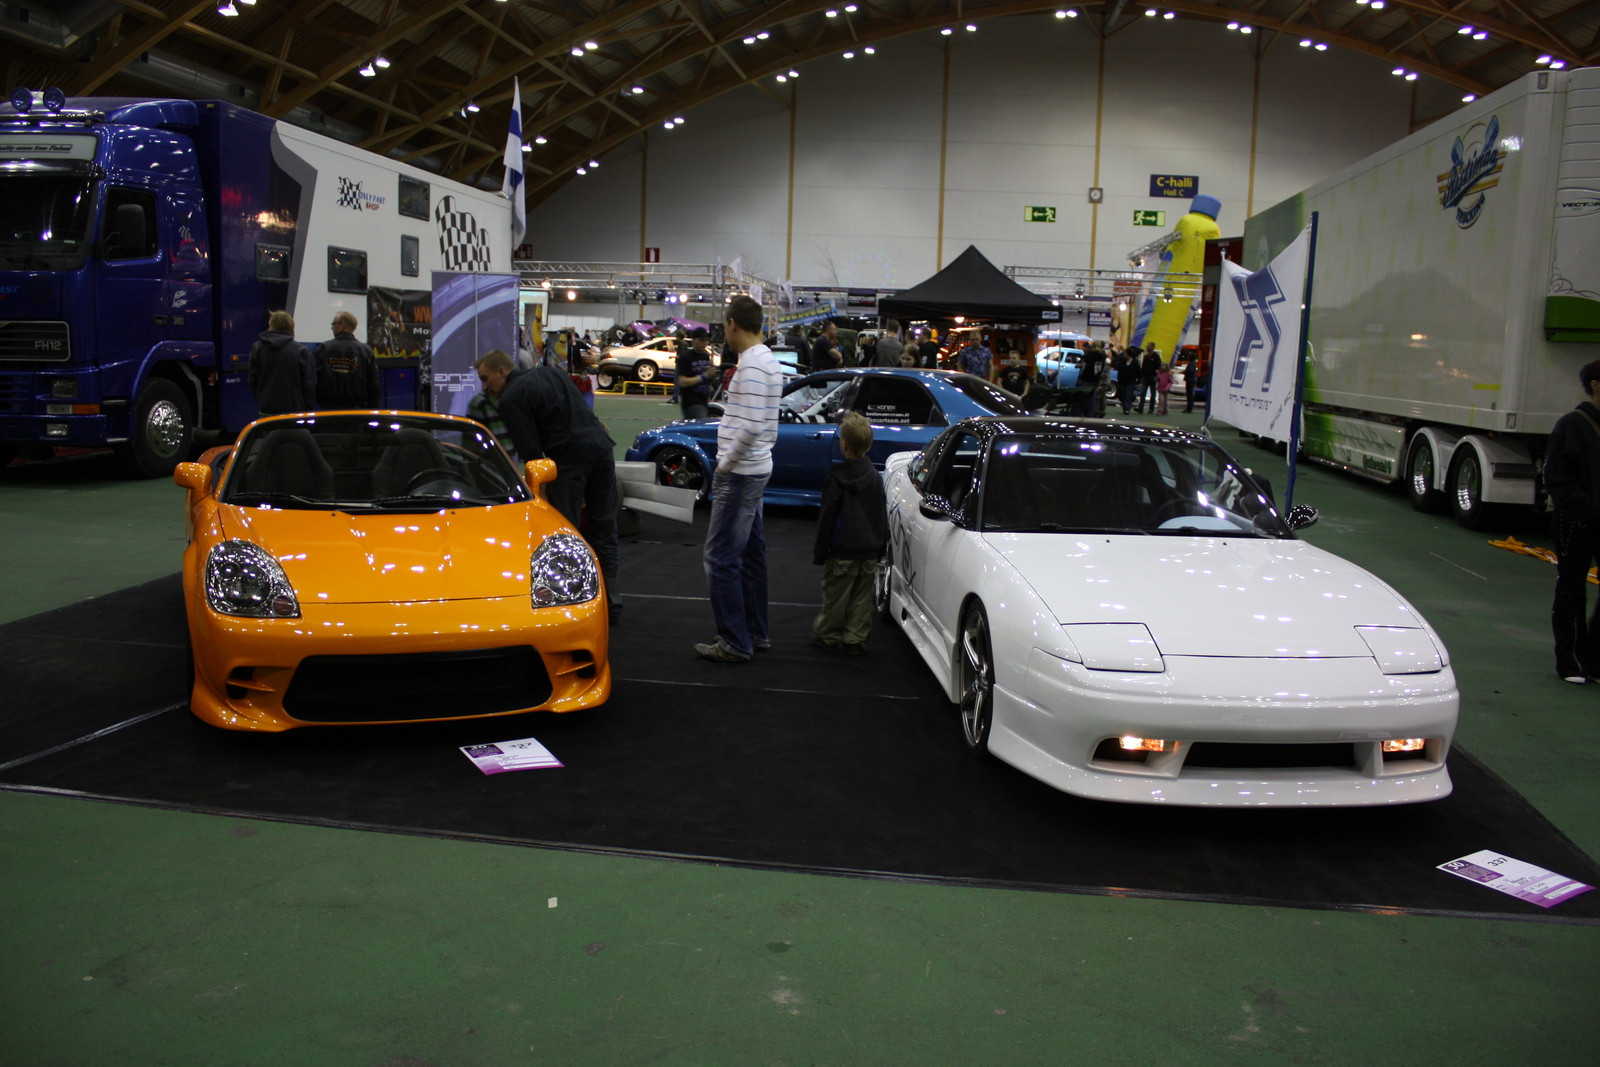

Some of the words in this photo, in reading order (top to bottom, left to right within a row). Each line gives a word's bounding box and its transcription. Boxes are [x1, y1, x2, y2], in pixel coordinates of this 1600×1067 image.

[1156, 176, 1193, 187] C-halli
[1163, 188, 1177, 196] Hall
[1178, 189, 1185, 197] C
[373, 195, 385, 204] FAST
[366, 202, 380, 211] SHOP
[34, 340, 62, 351] FH12
[1487, 857, 1508, 867] 337
